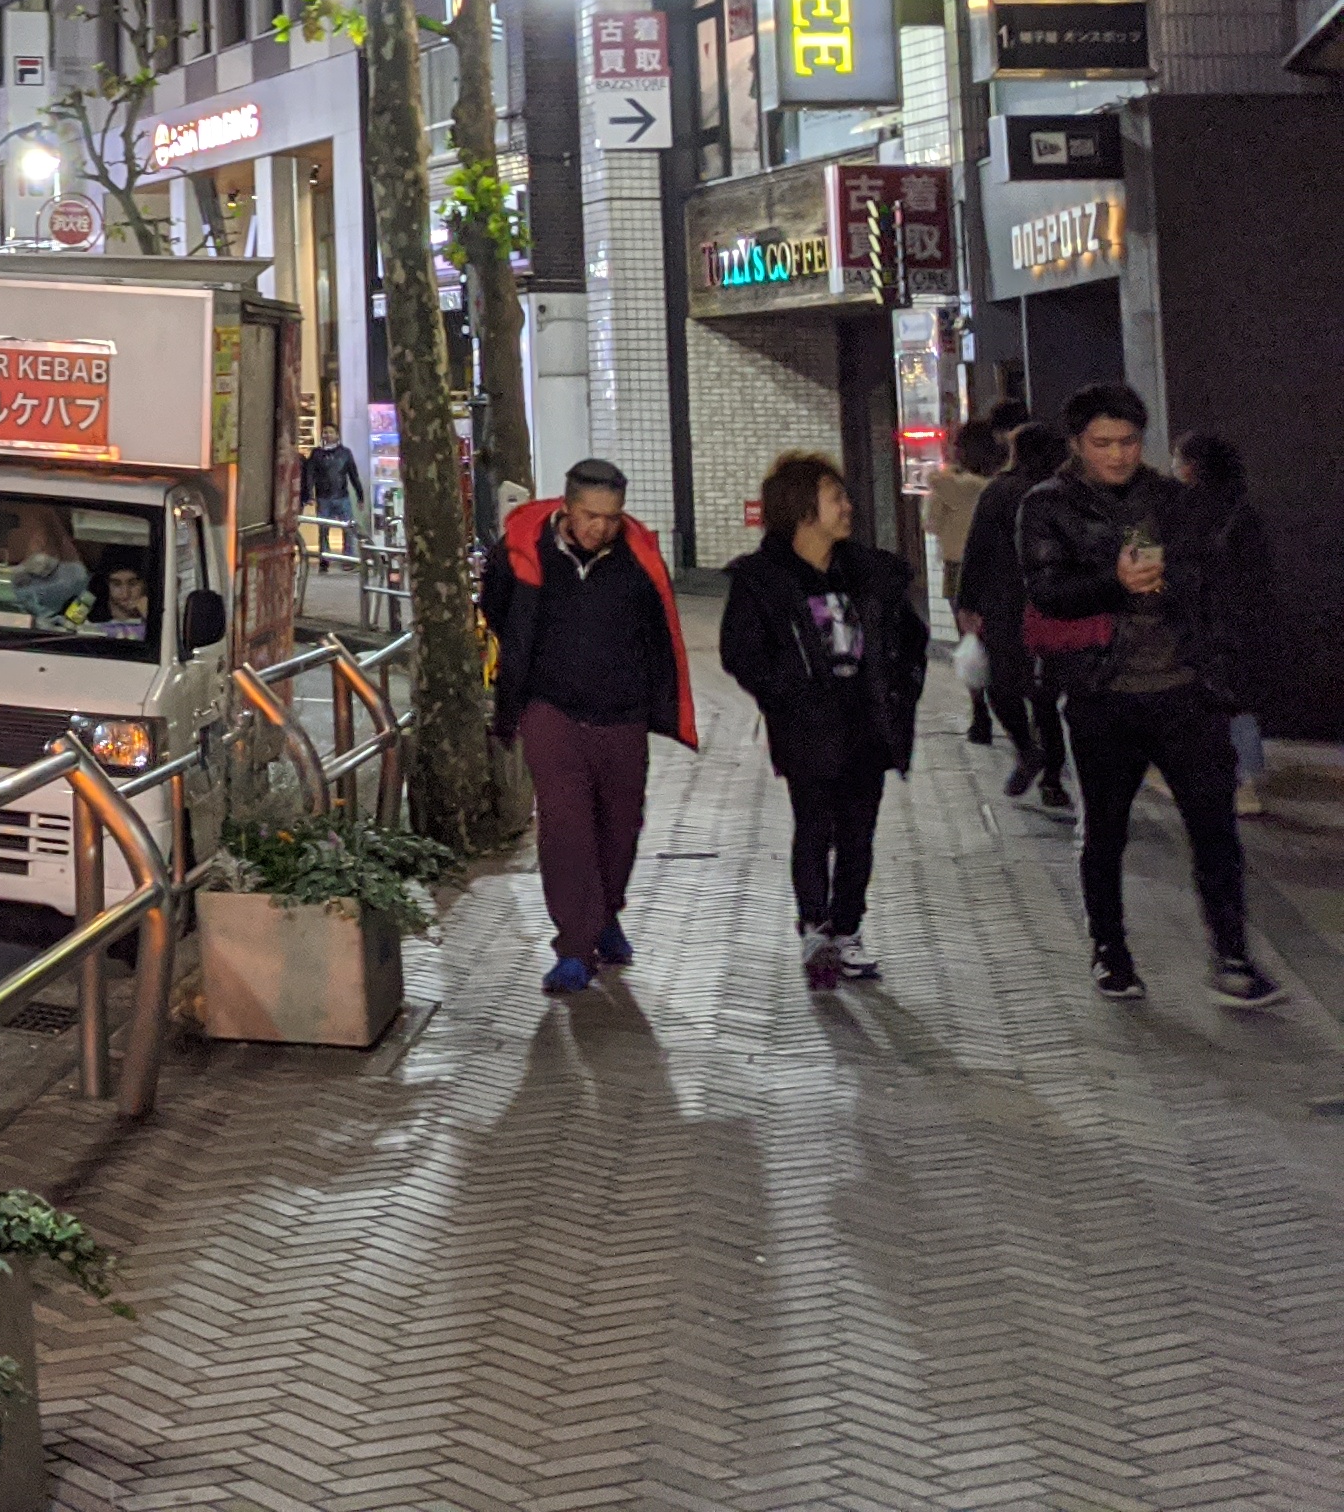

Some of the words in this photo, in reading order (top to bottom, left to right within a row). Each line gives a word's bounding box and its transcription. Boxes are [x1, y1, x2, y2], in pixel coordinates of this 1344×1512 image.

[599, 17, 661, 44] 古着
[600, 47, 662, 74] 買取
[14, 354, 108, 384] KEBAB
